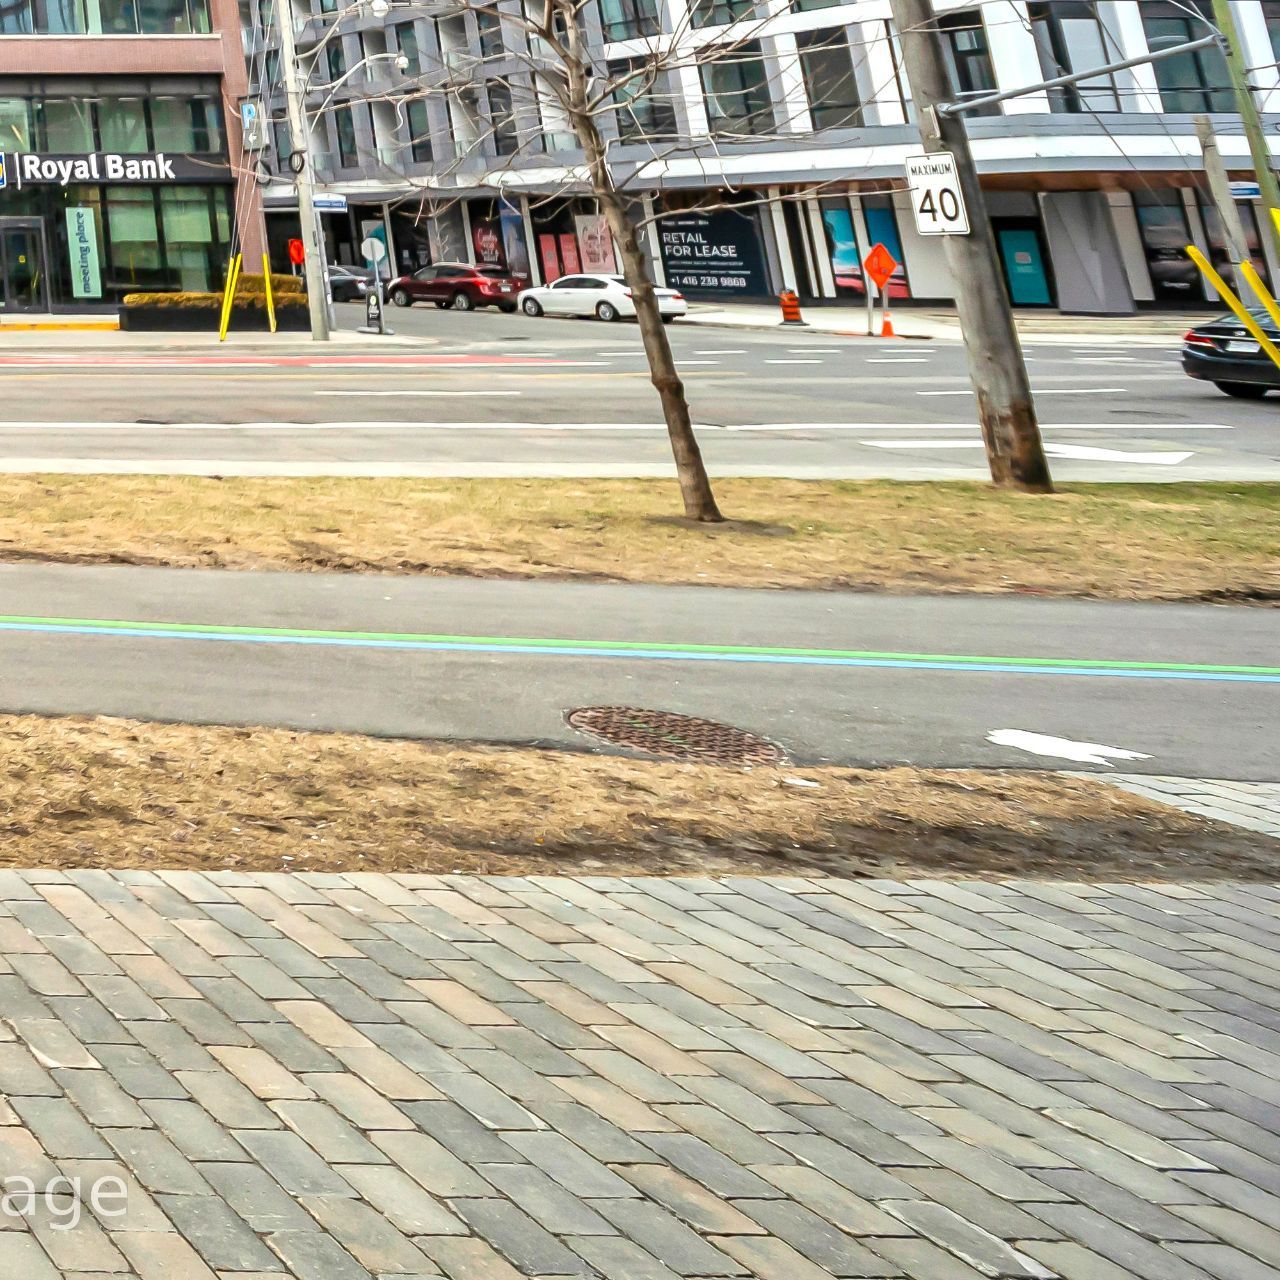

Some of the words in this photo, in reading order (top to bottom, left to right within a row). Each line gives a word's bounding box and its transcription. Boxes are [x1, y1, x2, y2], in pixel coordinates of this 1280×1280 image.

[22, 153, 100, 187] Royal
[105, 153, 176, 180] Bank
[910, 163, 953, 176] MAXIMUM
[919, 187, 960, 222] 40
[75, 211, 89, 243] place
[662, 232, 707, 244] RETAIL
[665, 245, 692, 257] FOR
[695, 245, 738, 258] LEASE
[79, 246, 91, 293] meeting
